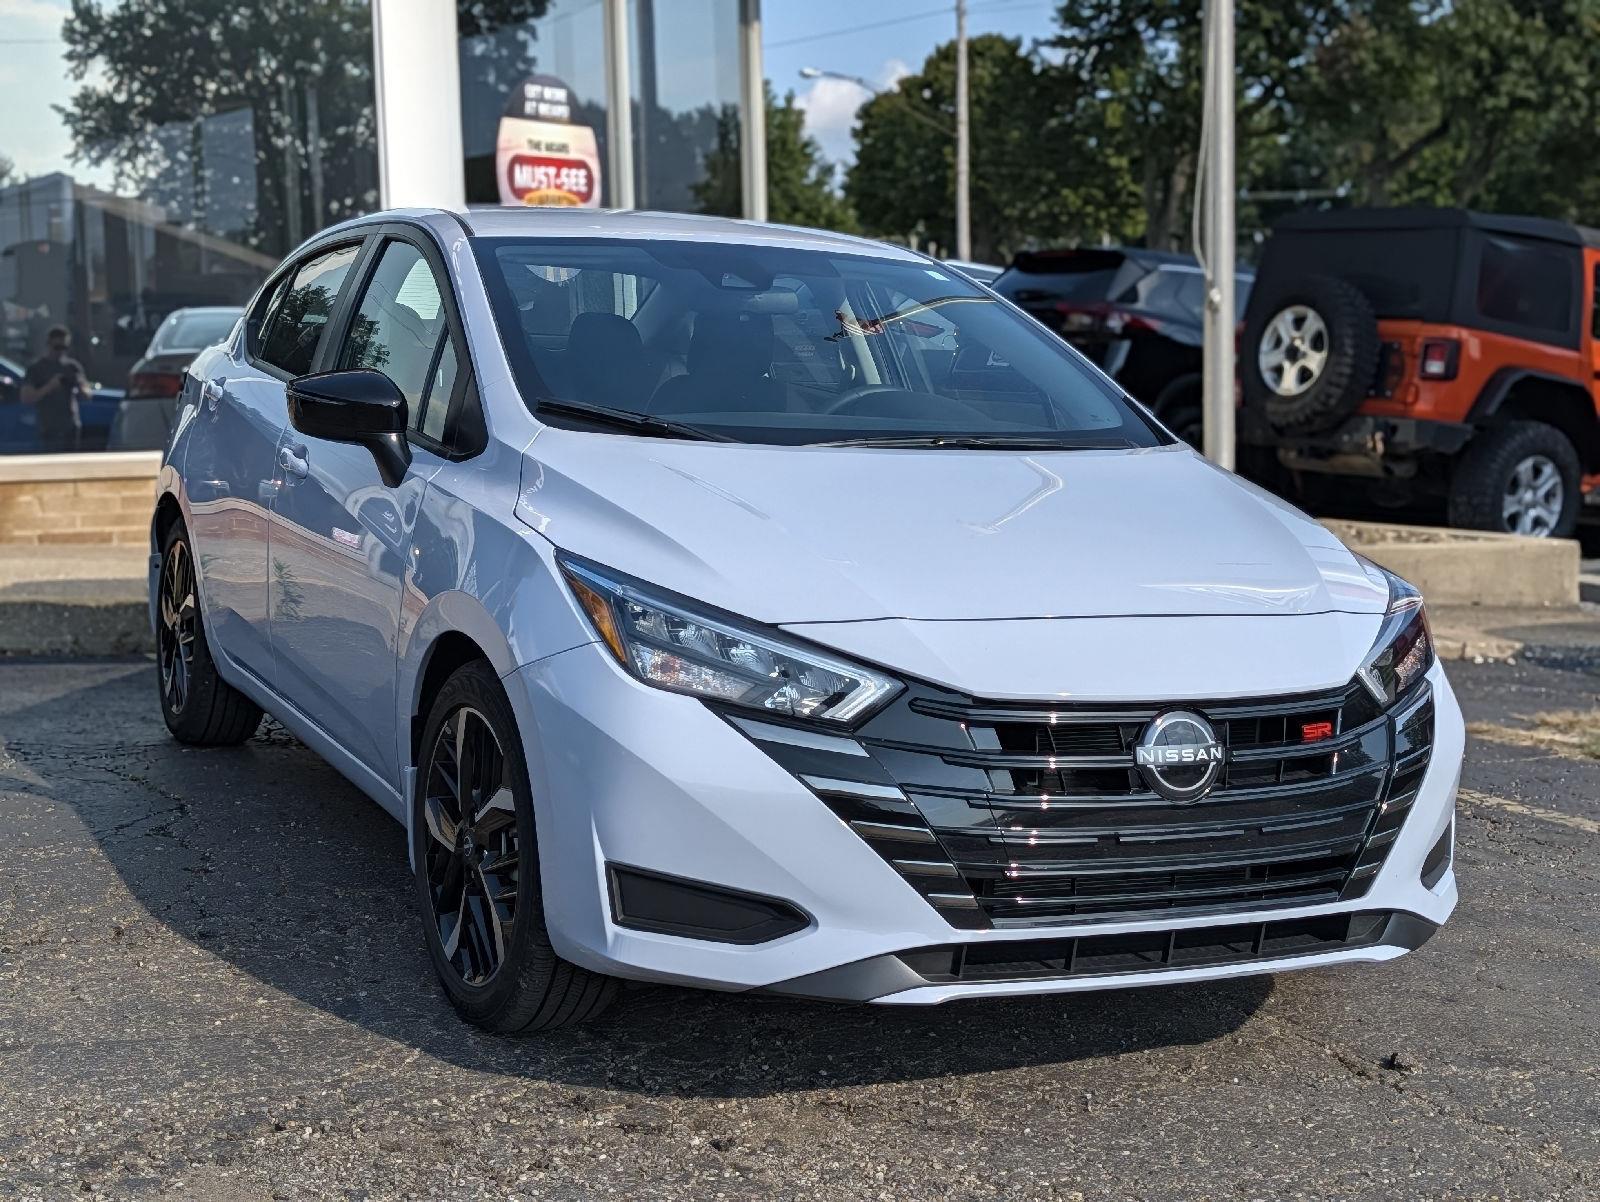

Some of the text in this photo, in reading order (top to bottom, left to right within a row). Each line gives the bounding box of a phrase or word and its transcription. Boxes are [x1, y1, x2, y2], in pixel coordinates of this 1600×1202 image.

[514, 163, 588, 193] MUST-SEE
[1302, 722, 1332, 739] SR
[1139, 746, 1223, 763] NISSAN
